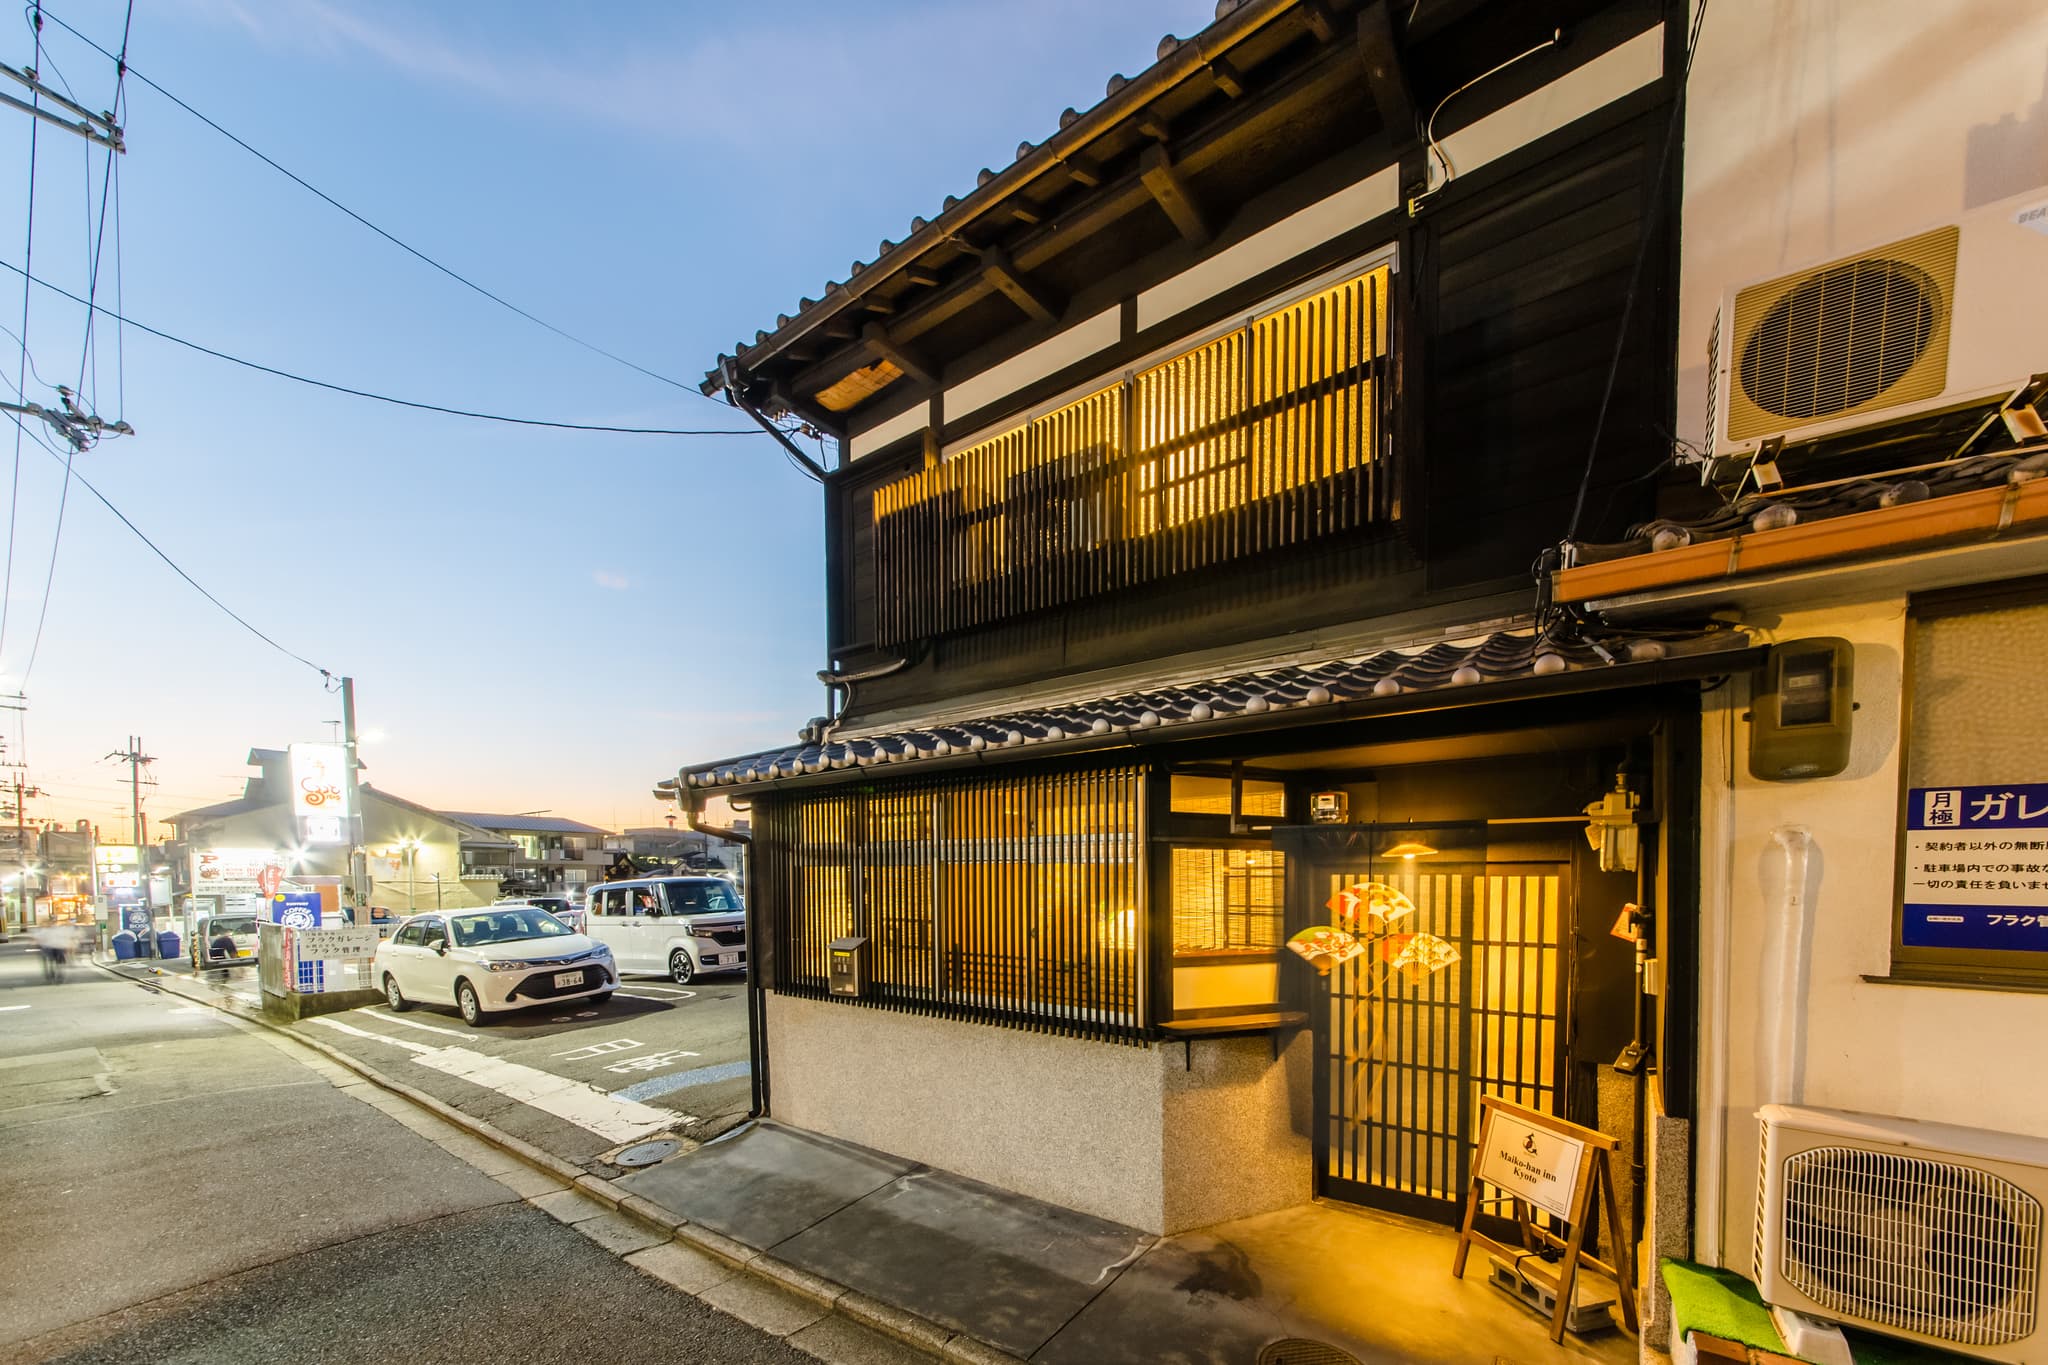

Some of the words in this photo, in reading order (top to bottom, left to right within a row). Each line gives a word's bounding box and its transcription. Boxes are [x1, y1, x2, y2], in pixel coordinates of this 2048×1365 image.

[1929, 792, 1954, 825] 月極
[1500, 1150, 1541, 1175] Maiko-han
[1543, 1169, 1557, 1182] inn
[1513, 1166, 1537, 1184] Kyoto
